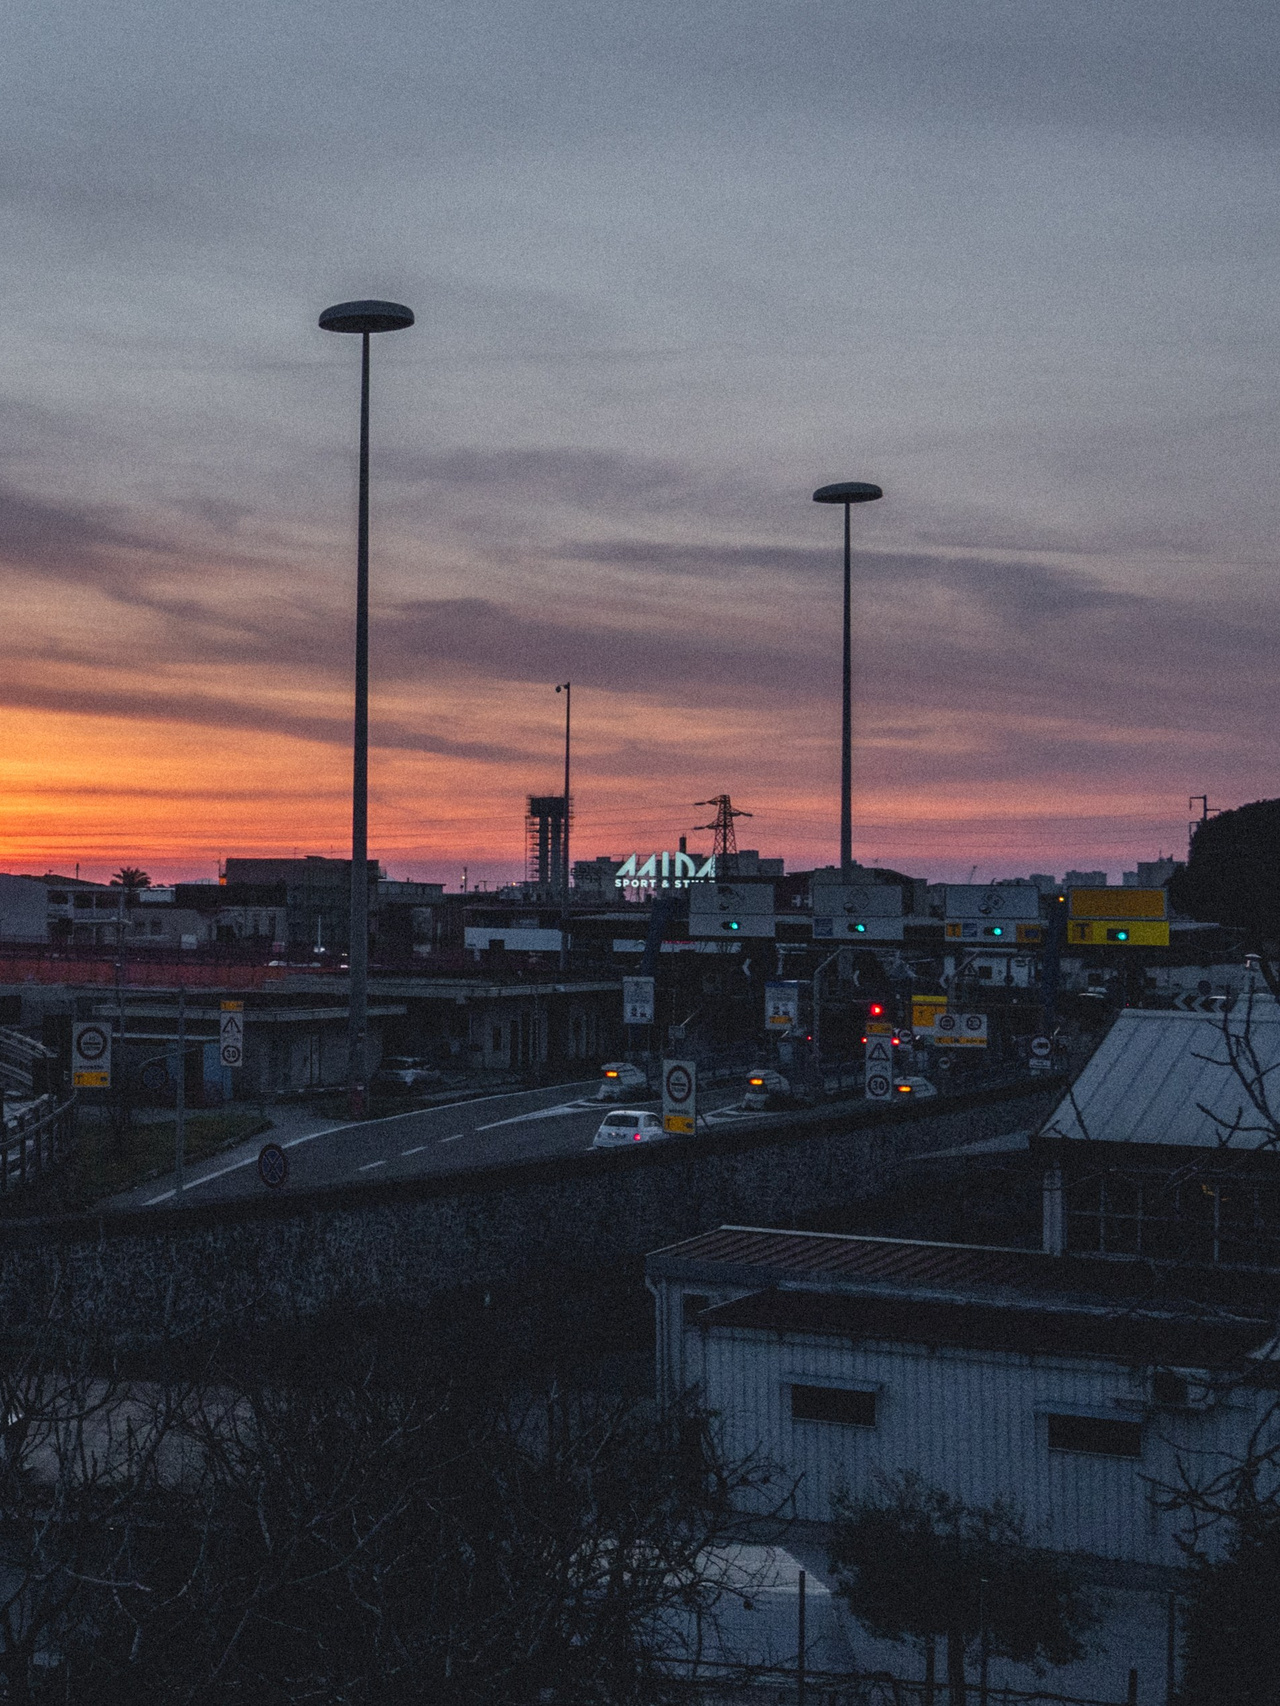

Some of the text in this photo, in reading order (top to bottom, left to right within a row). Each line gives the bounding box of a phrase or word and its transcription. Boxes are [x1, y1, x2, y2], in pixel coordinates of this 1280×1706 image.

[615, 879, 656, 888] SPORT
[661, 880, 670, 888] &
[872, 1079, 885, 1091] 30
